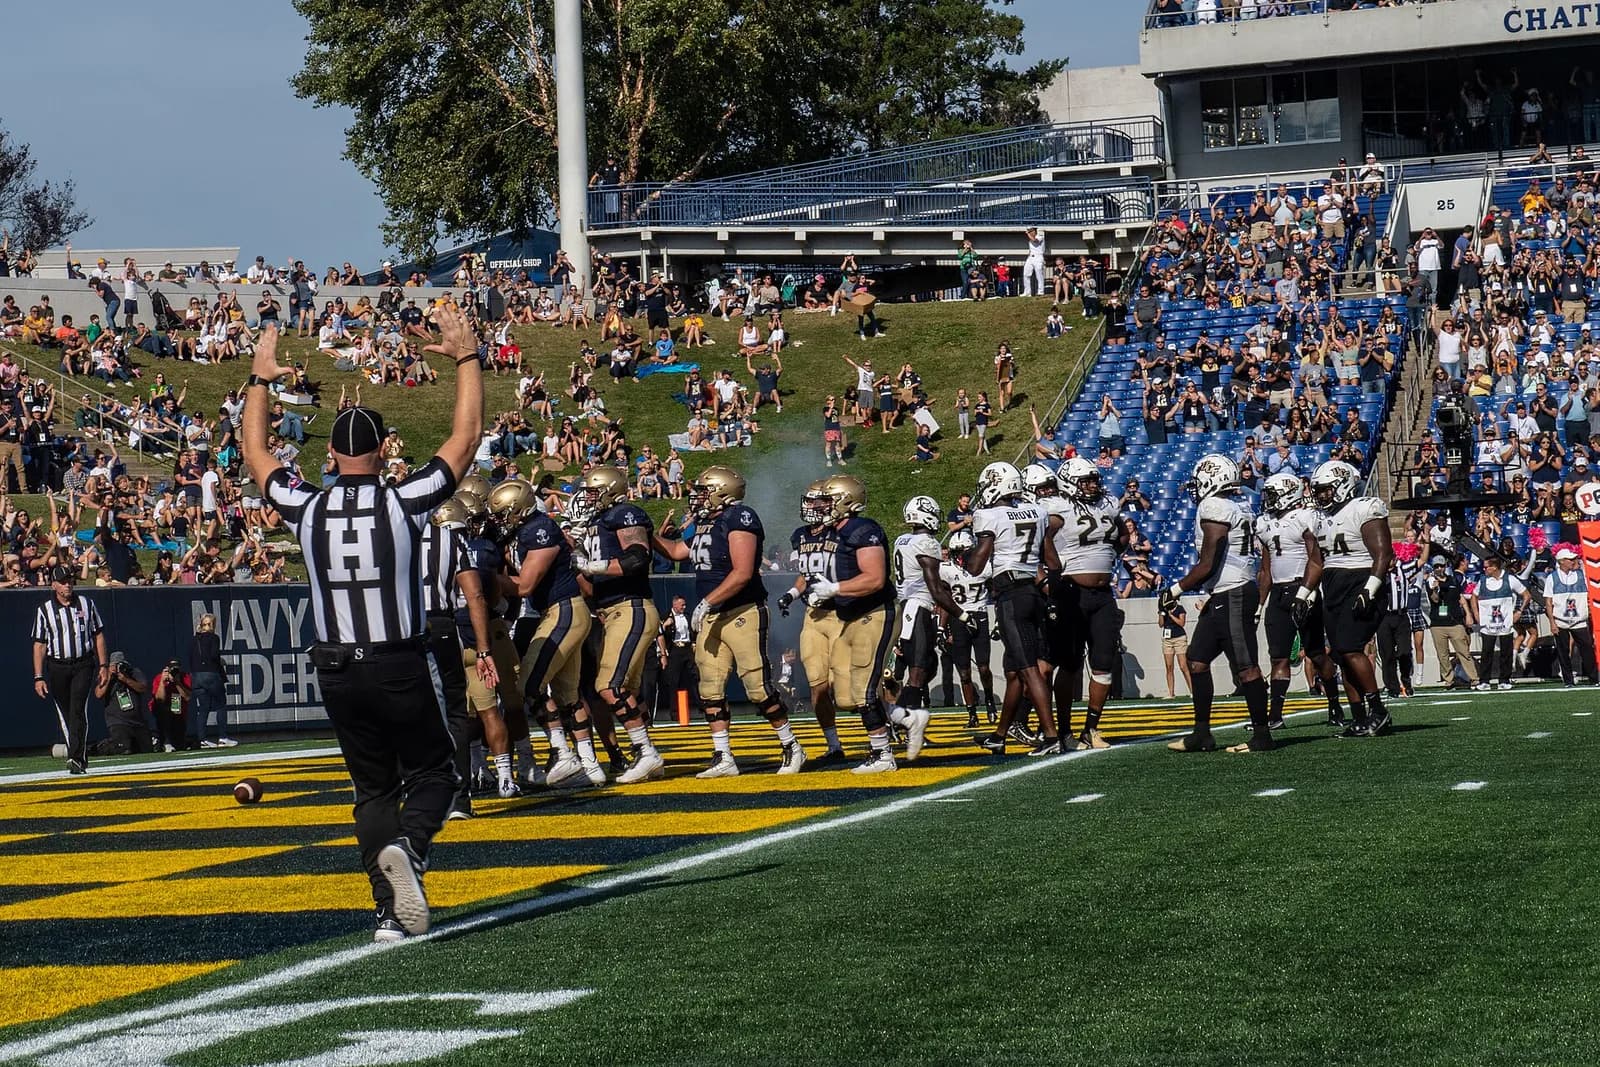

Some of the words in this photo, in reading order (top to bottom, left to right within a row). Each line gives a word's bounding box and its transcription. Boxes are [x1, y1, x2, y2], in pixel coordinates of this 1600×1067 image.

[1437, 199, 1455, 211] 25
[490, 260, 521, 269] OFFICIAL
[523, 258, 542, 267] SHOP
[346, 487, 355, 498] S
[1006, 509, 1039, 520] BROWN
[1077, 514, 1118, 546] 22
[325, 515, 381, 582] H
[800, 543, 823, 553] NAVY
[1014, 521, 1036, 563] 7
[1272, 535, 1282, 556] 1
[951, 583, 982, 605] 37
[191, 598, 309, 650] NAVY
[354, 647, 364, 660] S
